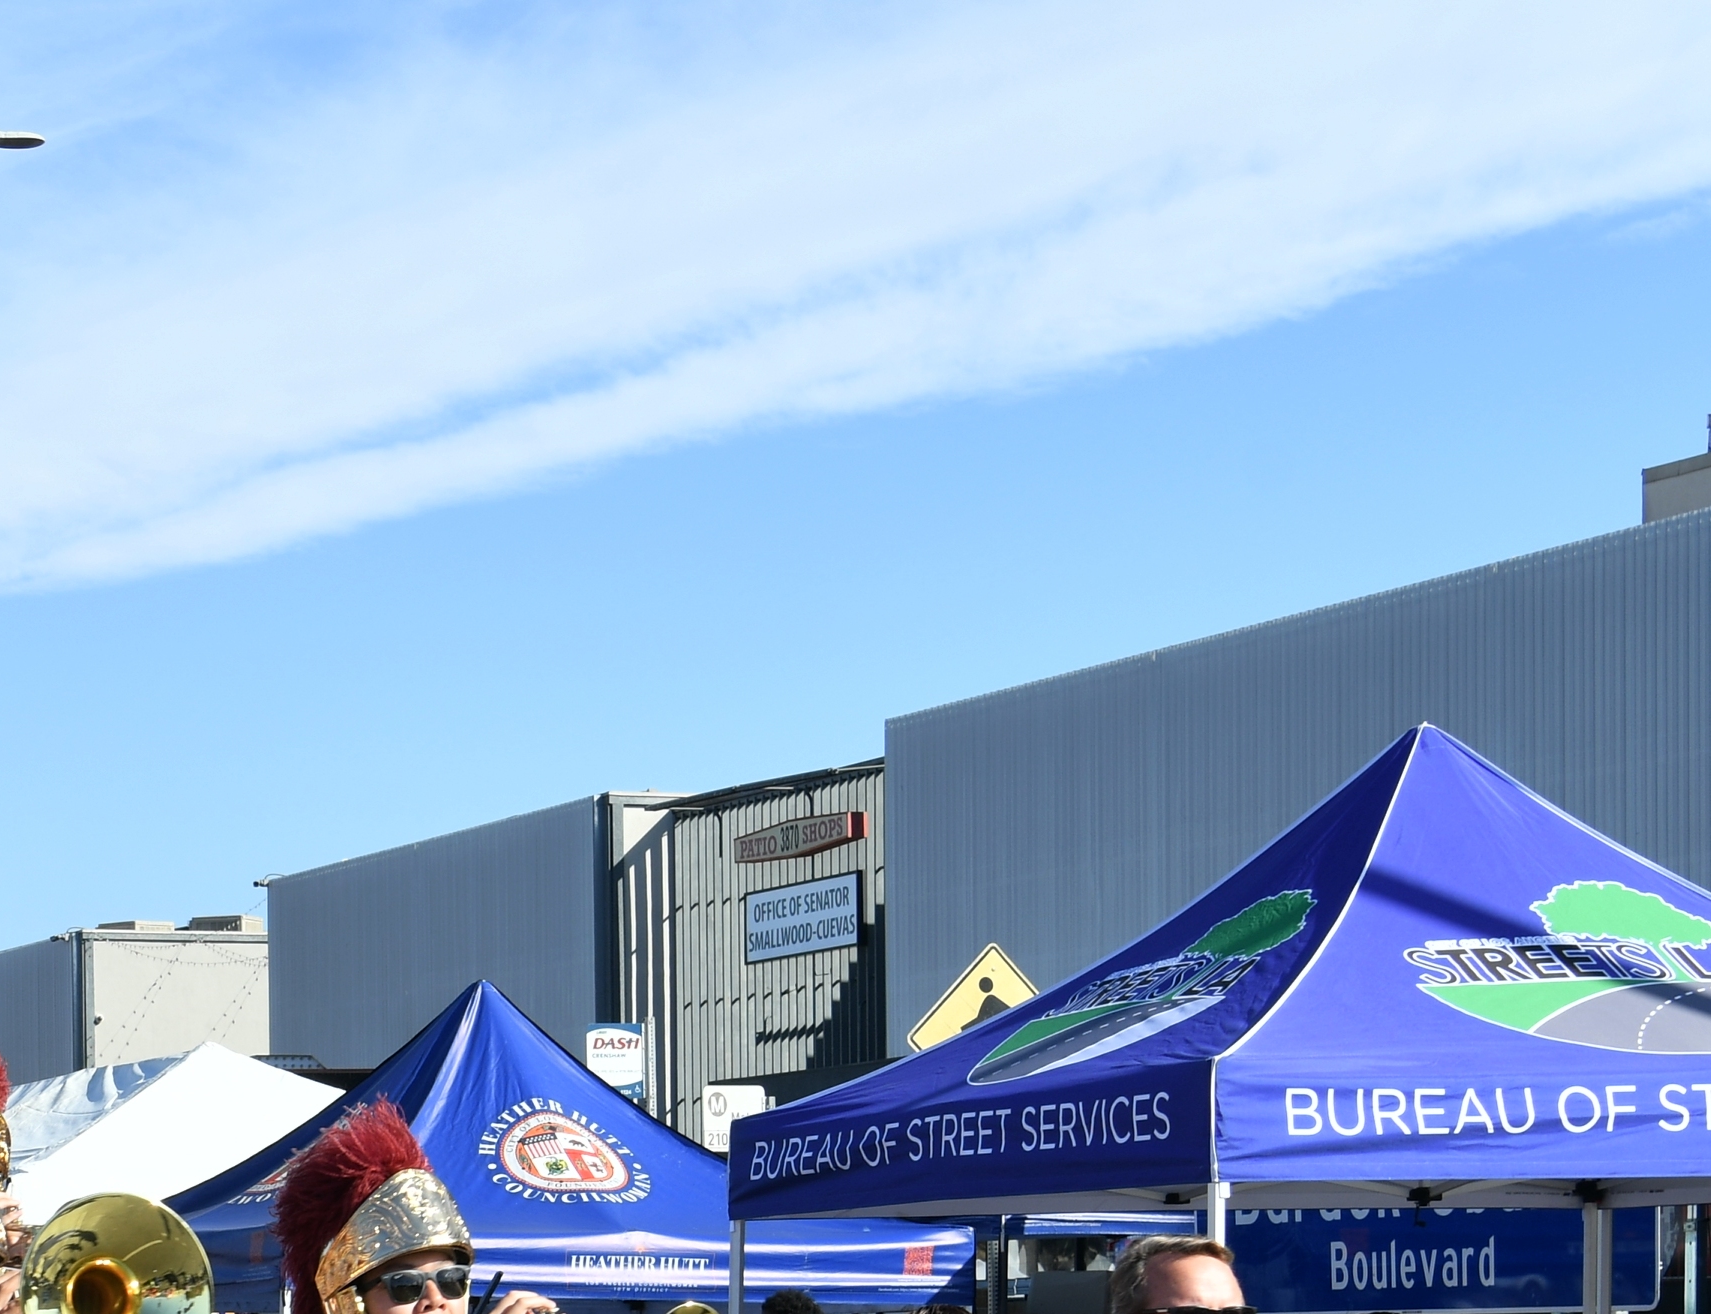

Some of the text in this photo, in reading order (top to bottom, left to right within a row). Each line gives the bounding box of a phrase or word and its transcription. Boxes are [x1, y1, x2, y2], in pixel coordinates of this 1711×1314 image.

[740, 817, 843, 859] PATIO 3870 SHOPS
[753, 886, 850, 923] OFFICE OF SENATOR
[748, 914, 856, 952] SMALLWOOD-CUEVAS
[1172, 956, 1261, 1000] LA
[1403, 942, 1676, 985] STREETS
[592, 1037, 640, 1050] DASH
[478, 1097, 634, 1157] HEATHER HUTT
[1284, 1086, 1536, 1137] BUREAU
[1557, 1084, 1637, 1133] OF
[708, 1133, 728, 1146] 210
[749, 1091, 1171, 1181] BUREAU OF STREET SERVICES
[492, 1173, 652, 1204] COUNCILWOMAN
[571, 1255, 709, 1272] HEATHER HUTT
[1330, 1236, 1496, 1291] Boulevard
